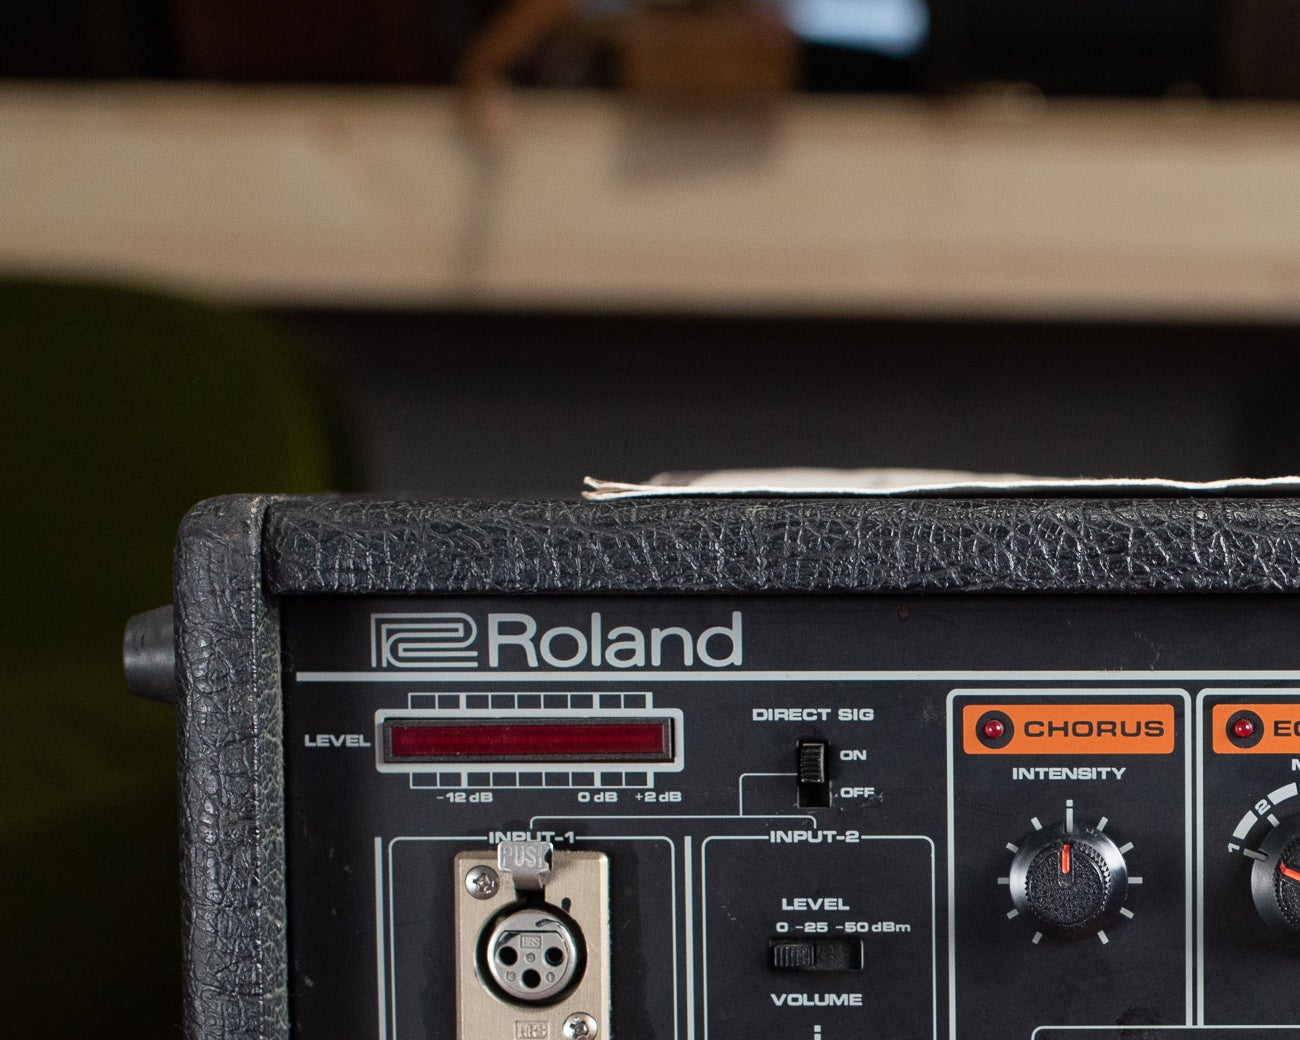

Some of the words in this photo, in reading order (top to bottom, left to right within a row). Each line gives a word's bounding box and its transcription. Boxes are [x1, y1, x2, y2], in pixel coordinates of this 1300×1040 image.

[488, 612, 742, 667] Roland
[752, 708, 832, 722] DIRECT
[837, 708, 875, 722] SIG
[1023, 720, 1165, 738] CHORUS
[304, 734, 371, 747] LEVEL
[839, 749, 867, 761] ON
[1012, 767, 1127, 780] INTENSITY
[839, 786, 875, 798] OFF
[1255, 799, 1271, 815] 2
[489, 831, 574, 844] INPUT-1
[770, 829, 859, 844] INPUT-2
[1228, 844, 1240, 853] 1
[781, 897, 850, 911] LEVEL
[770, 993, 863, 1007] VOLUME
